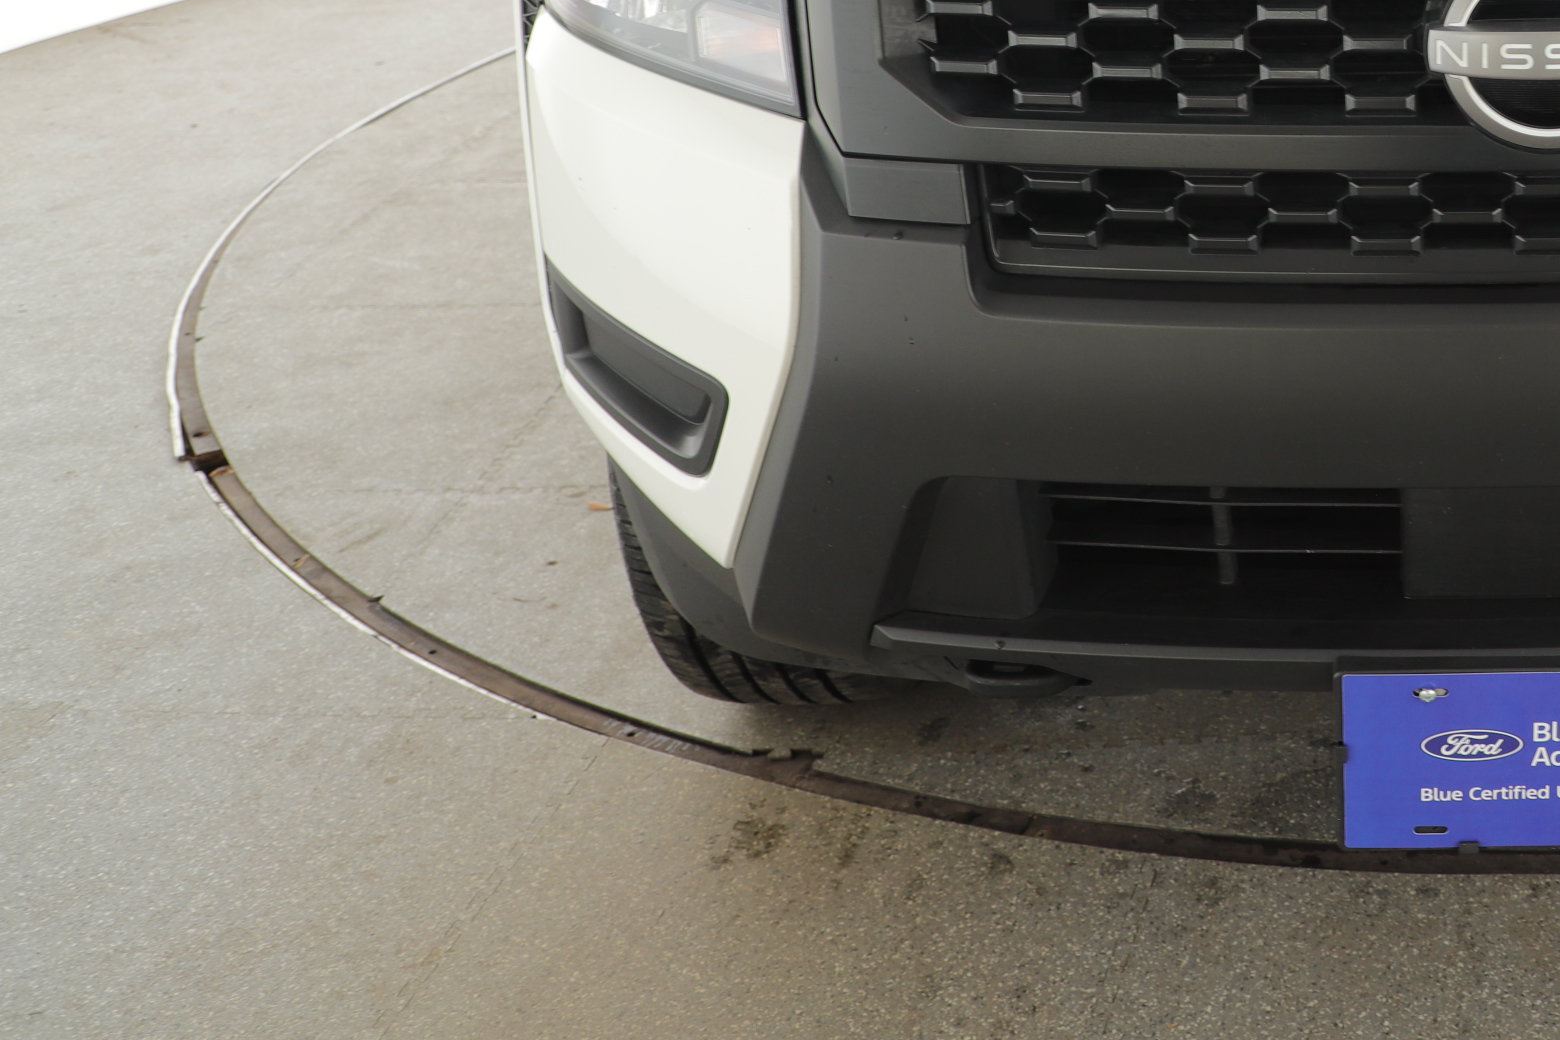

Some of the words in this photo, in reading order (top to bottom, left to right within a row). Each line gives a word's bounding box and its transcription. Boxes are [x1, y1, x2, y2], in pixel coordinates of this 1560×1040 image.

[1440, 733, 1503, 756] Ford
[1420, 787, 1464, 802] Blue
[1468, 784, 1551, 801] Certified
